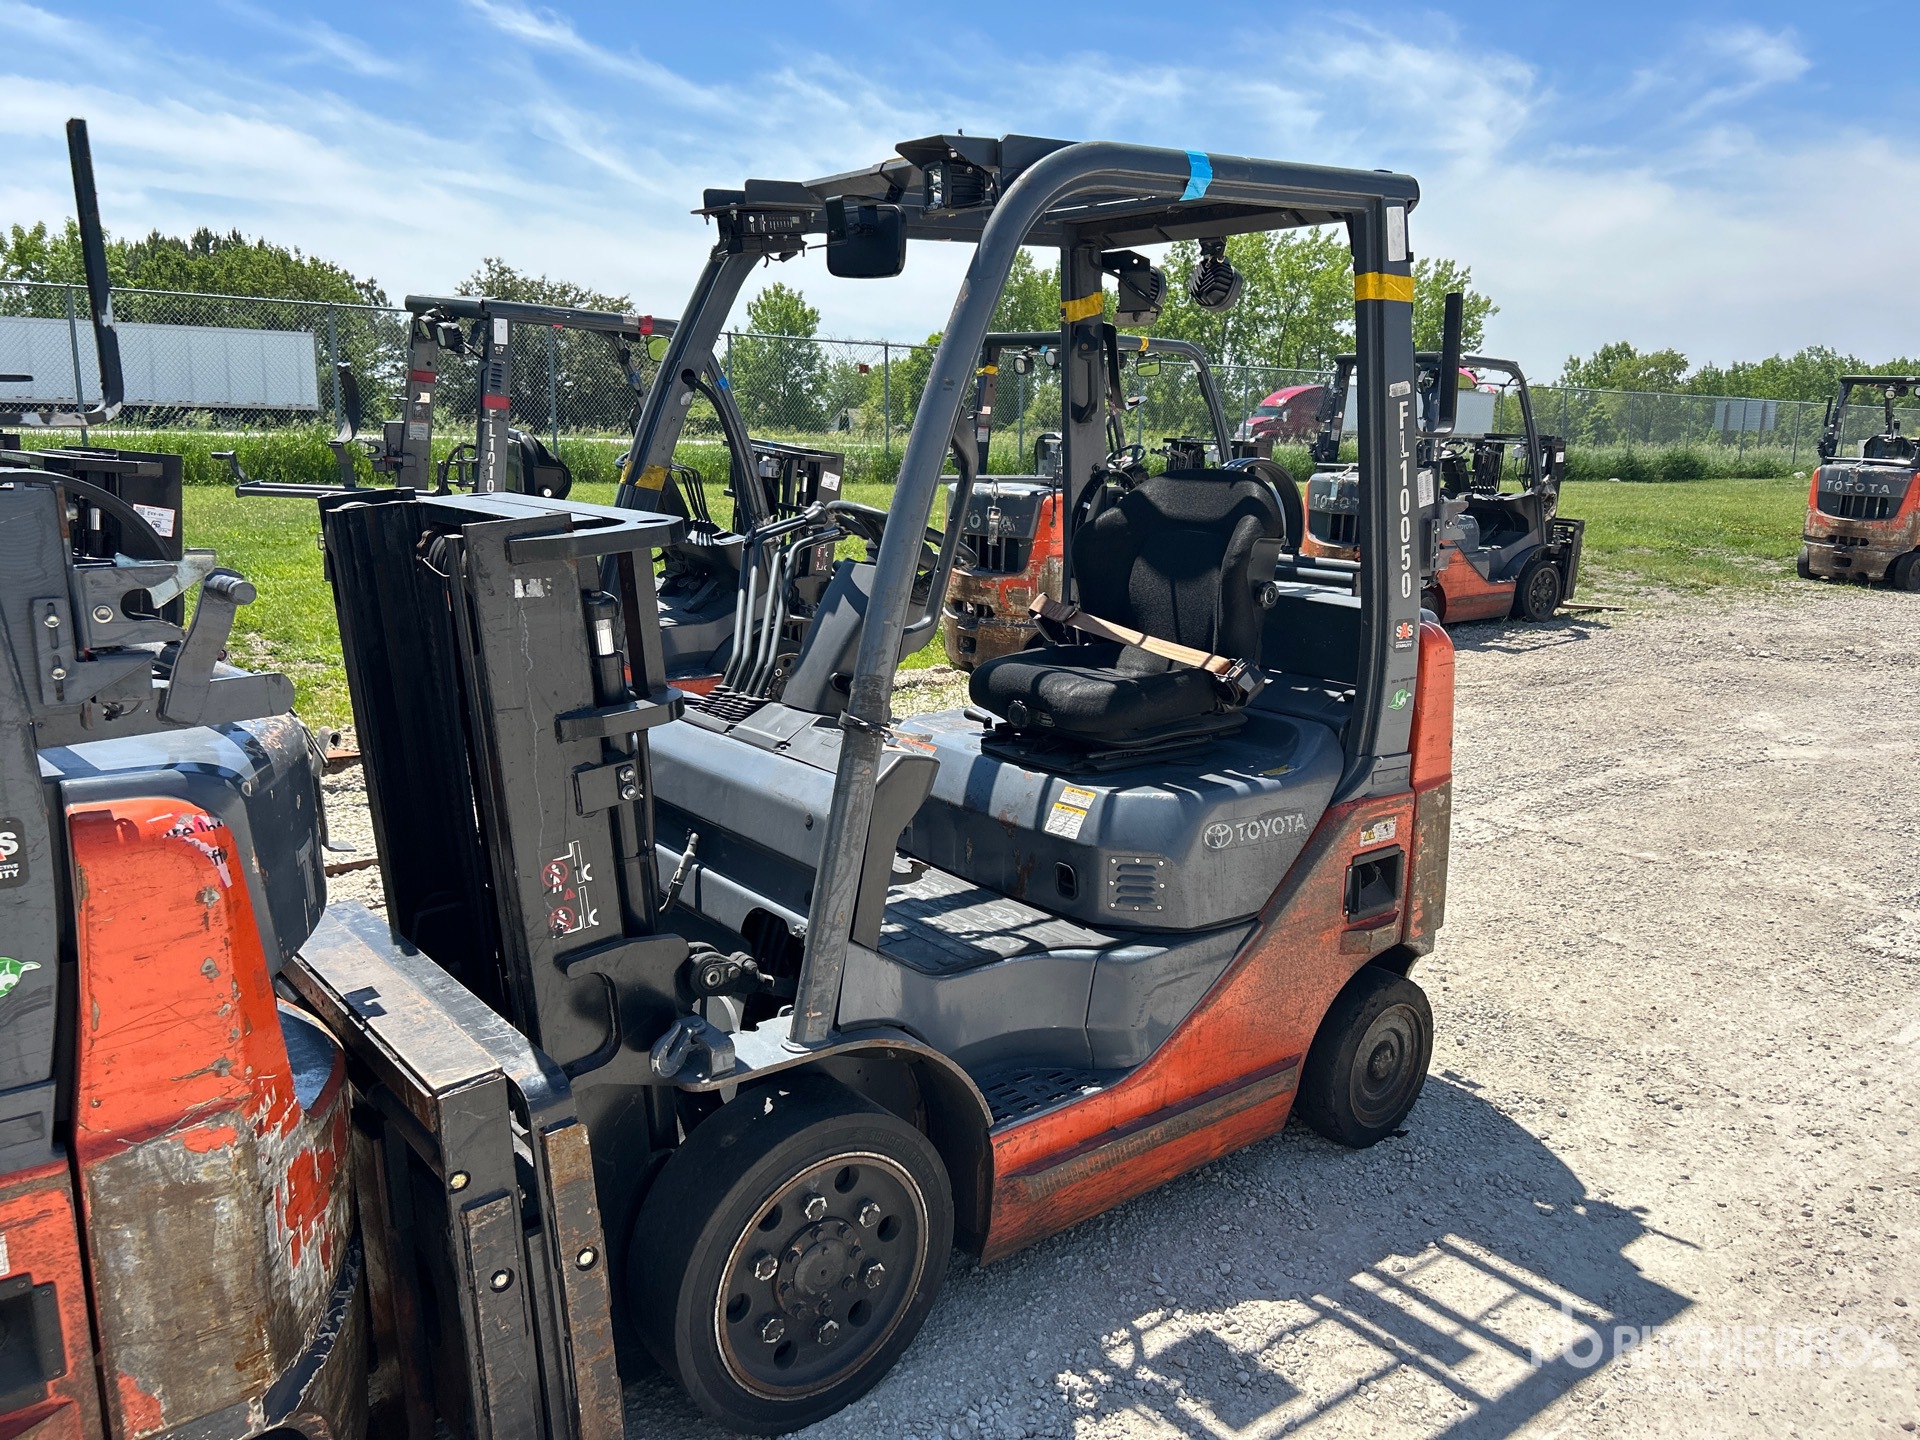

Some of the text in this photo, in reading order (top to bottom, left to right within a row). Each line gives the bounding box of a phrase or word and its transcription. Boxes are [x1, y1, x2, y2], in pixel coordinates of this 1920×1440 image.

[1399, 401, 1412, 599] FL10050
[1395, 622, 1414, 640] SAS
[1235, 813, 1307, 842] TOYOTA
